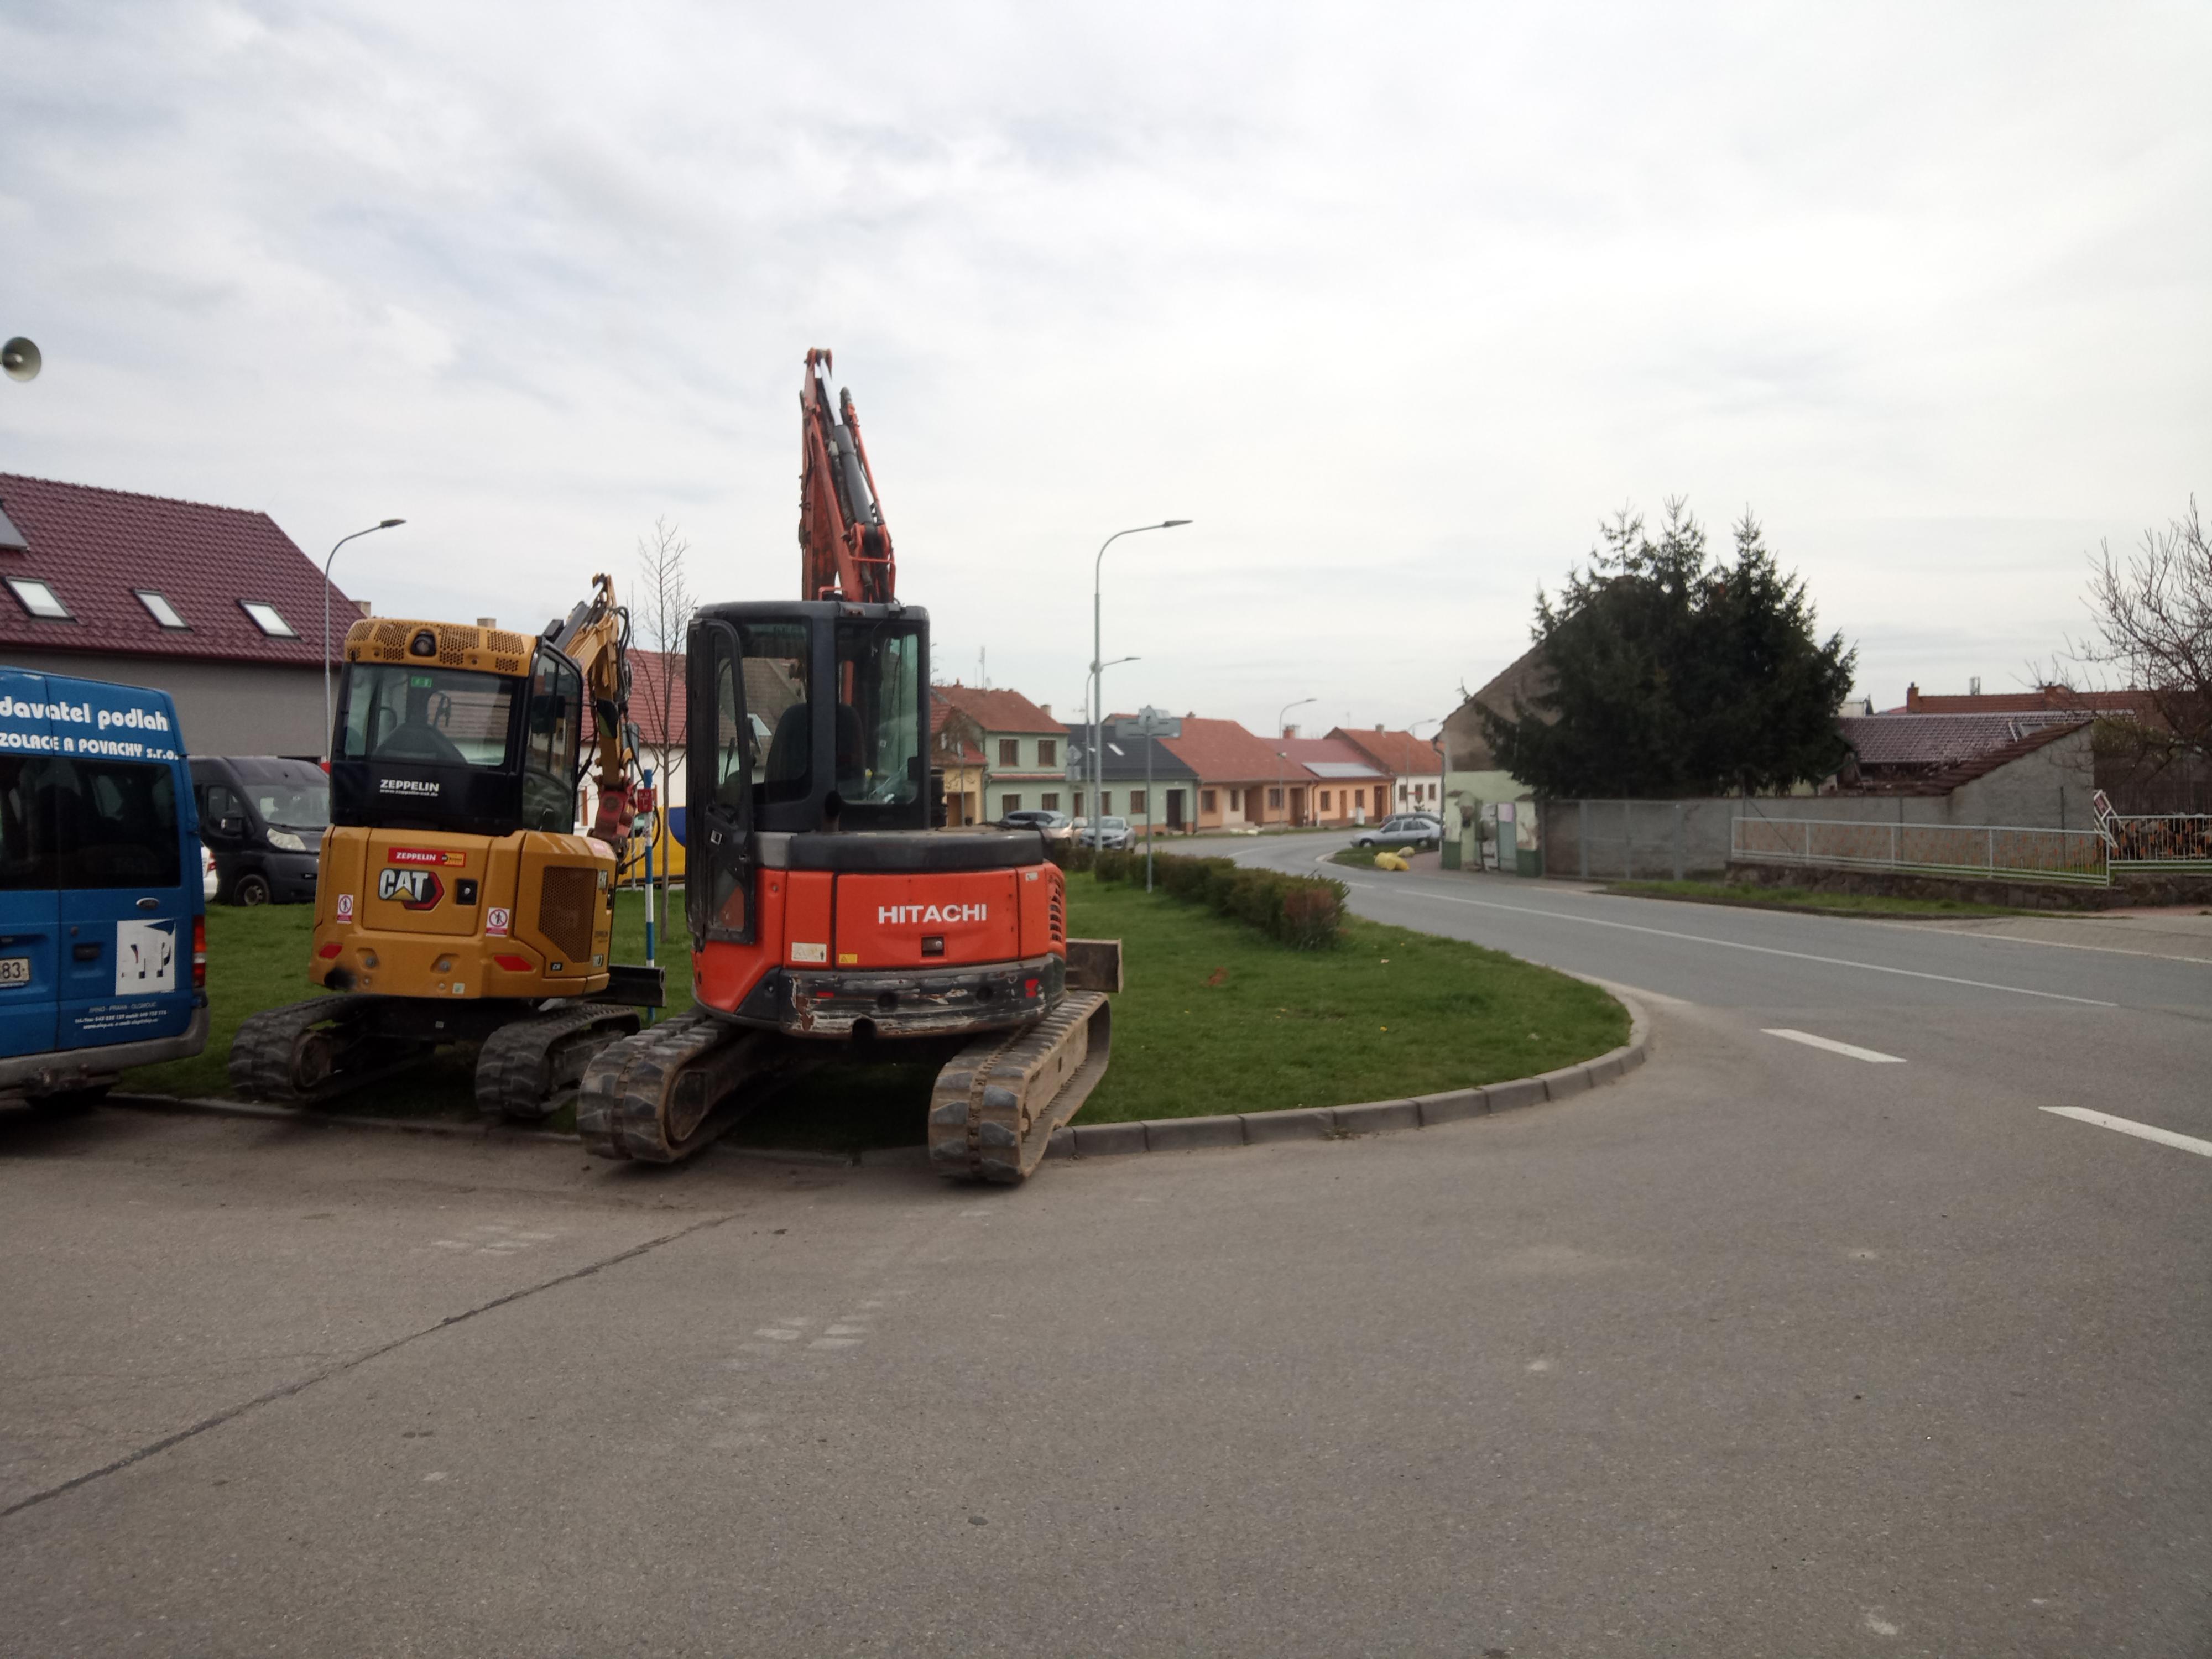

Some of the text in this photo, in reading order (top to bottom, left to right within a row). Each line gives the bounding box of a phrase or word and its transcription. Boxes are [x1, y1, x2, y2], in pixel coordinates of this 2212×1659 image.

[97, 708, 169, 732] podlah
[64, 737, 74, 752] A
[79, 738, 143, 757] POVRCHY
[146, 748, 179, 761] s.r.o.
[380, 779, 440, 792] ZEPPELIN
[396, 852, 437, 862] ZEPPELIN
[379, 869, 429, 902] CAT
[878, 904, 987, 924] HITACHI
